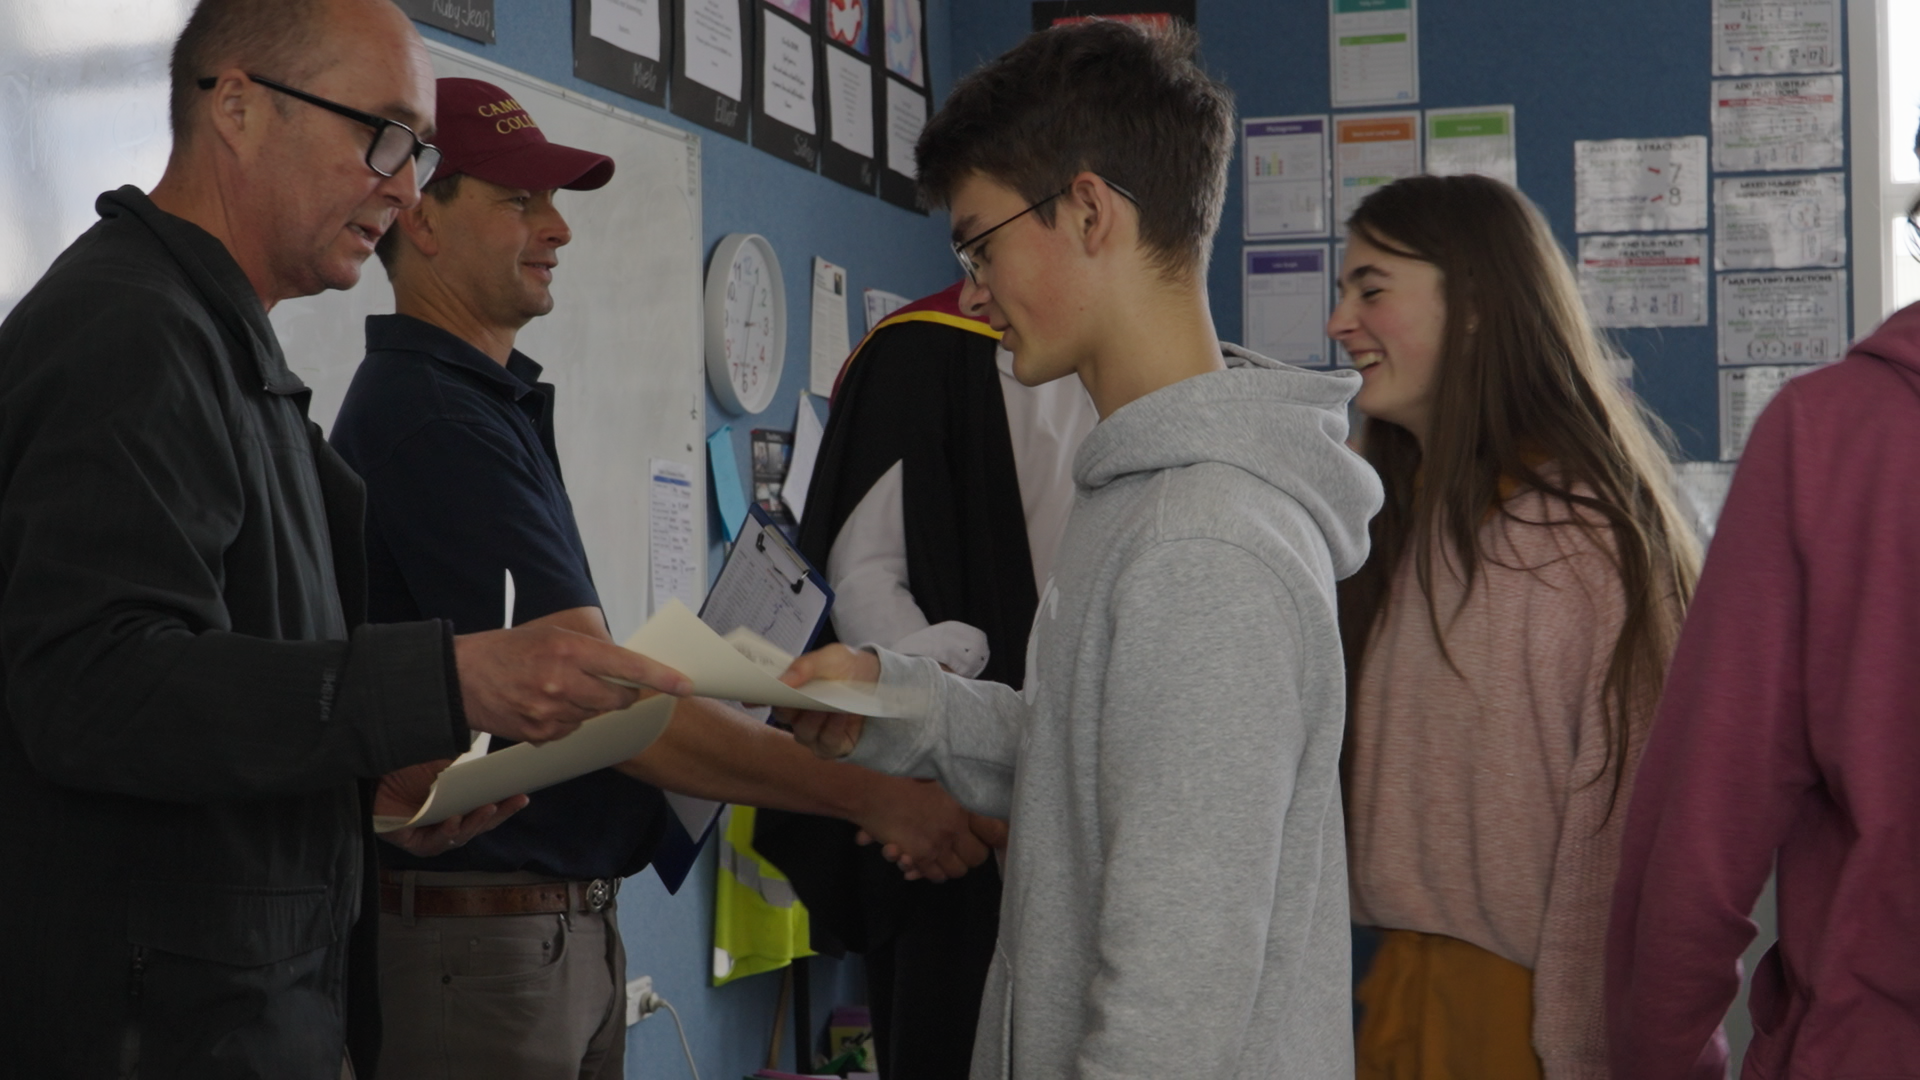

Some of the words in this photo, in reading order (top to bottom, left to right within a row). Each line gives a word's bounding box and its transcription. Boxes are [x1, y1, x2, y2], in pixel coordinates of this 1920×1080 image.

[1644, 142, 1691, 151] FRACTION
[1669, 162, 1682, 184] 7
[1740, 181, 1766, 189] MIXED
[1768, 180, 1802, 188] NUMBER
[1779, 188, 1822, 197] FRACTION
[1669, 187, 1682, 206] 8
[1728, 276, 1782, 286] MULTIPLYING
[1785, 275, 1833, 284] FRACTIONS
[761, 288, 767, 307] 2
[760, 345, 765, 362] 4
[733, 362, 739, 382] 7
